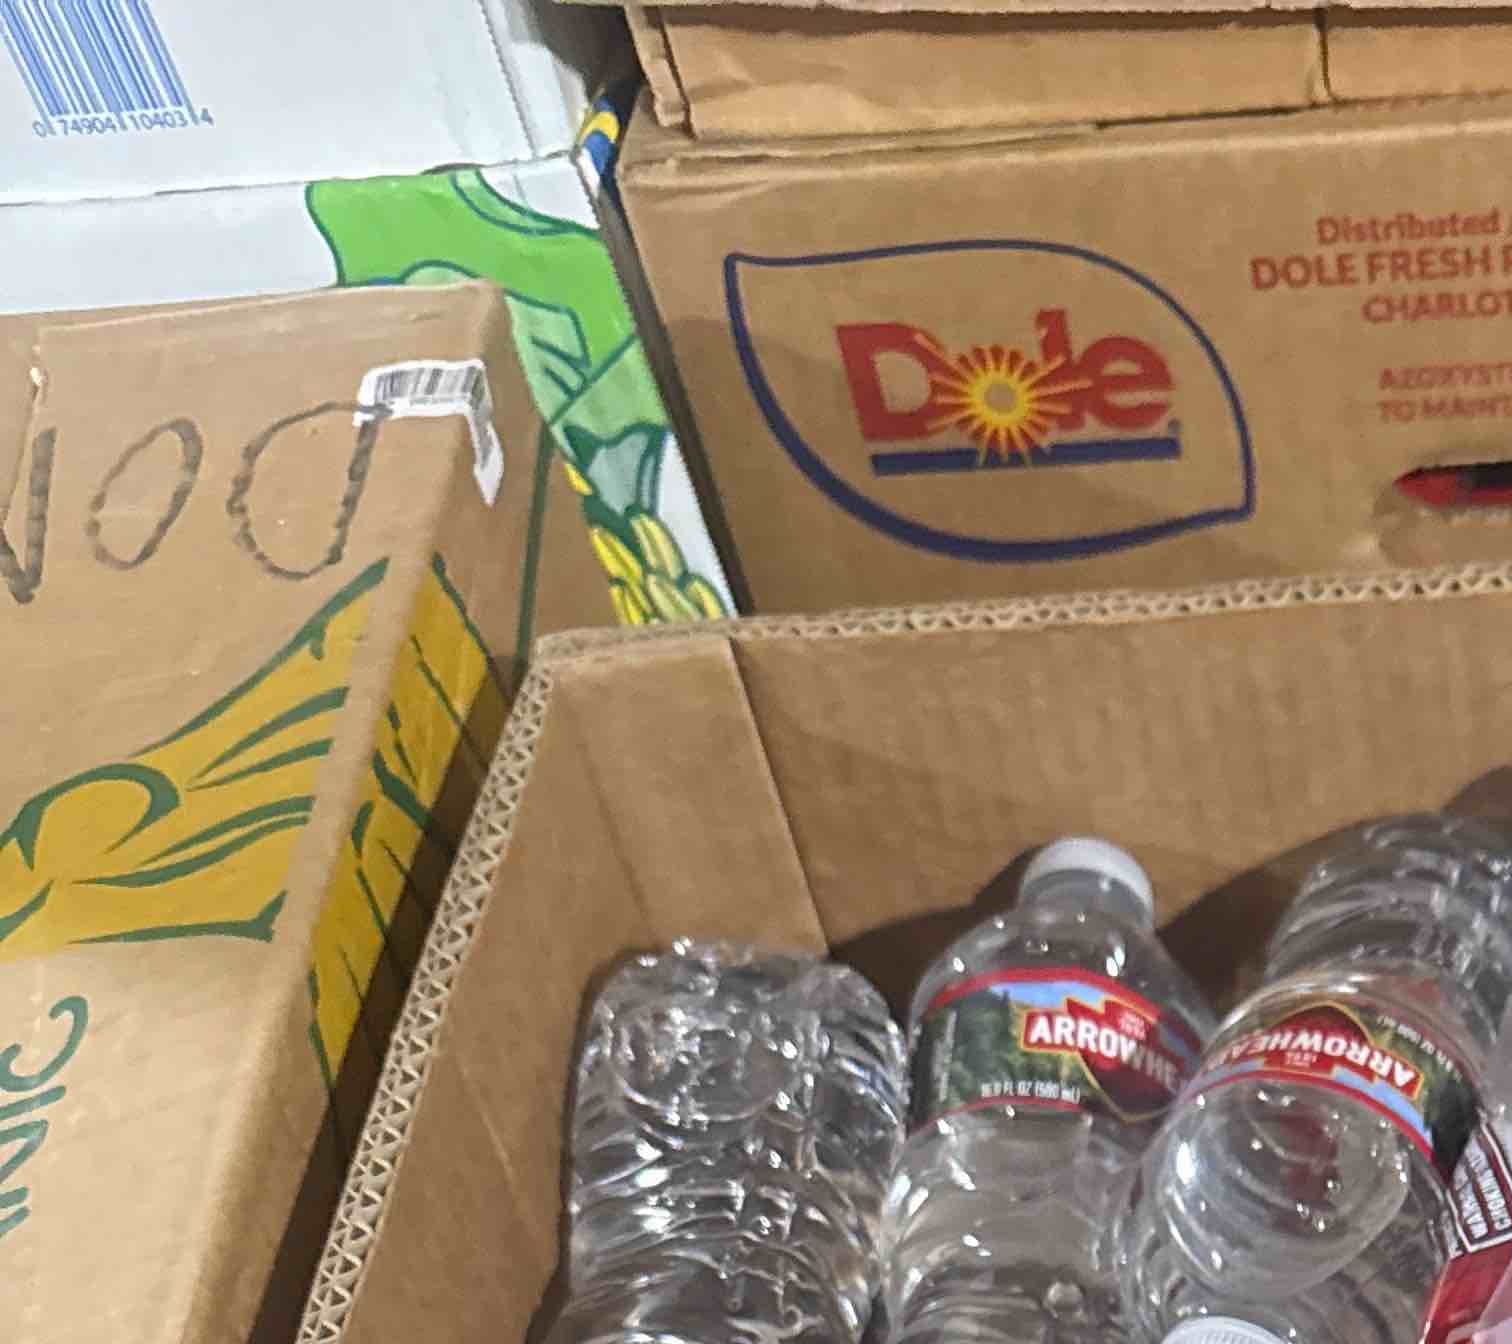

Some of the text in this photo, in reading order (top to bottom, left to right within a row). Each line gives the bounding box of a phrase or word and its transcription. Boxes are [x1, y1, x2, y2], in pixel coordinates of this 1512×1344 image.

[1315, 208, 1501, 245] Distributed
[1250, 253, 1359, 290] DOLE
[1366, 244, 1493, 285] FRESH
[836, 309, 1177, 447] Dole
